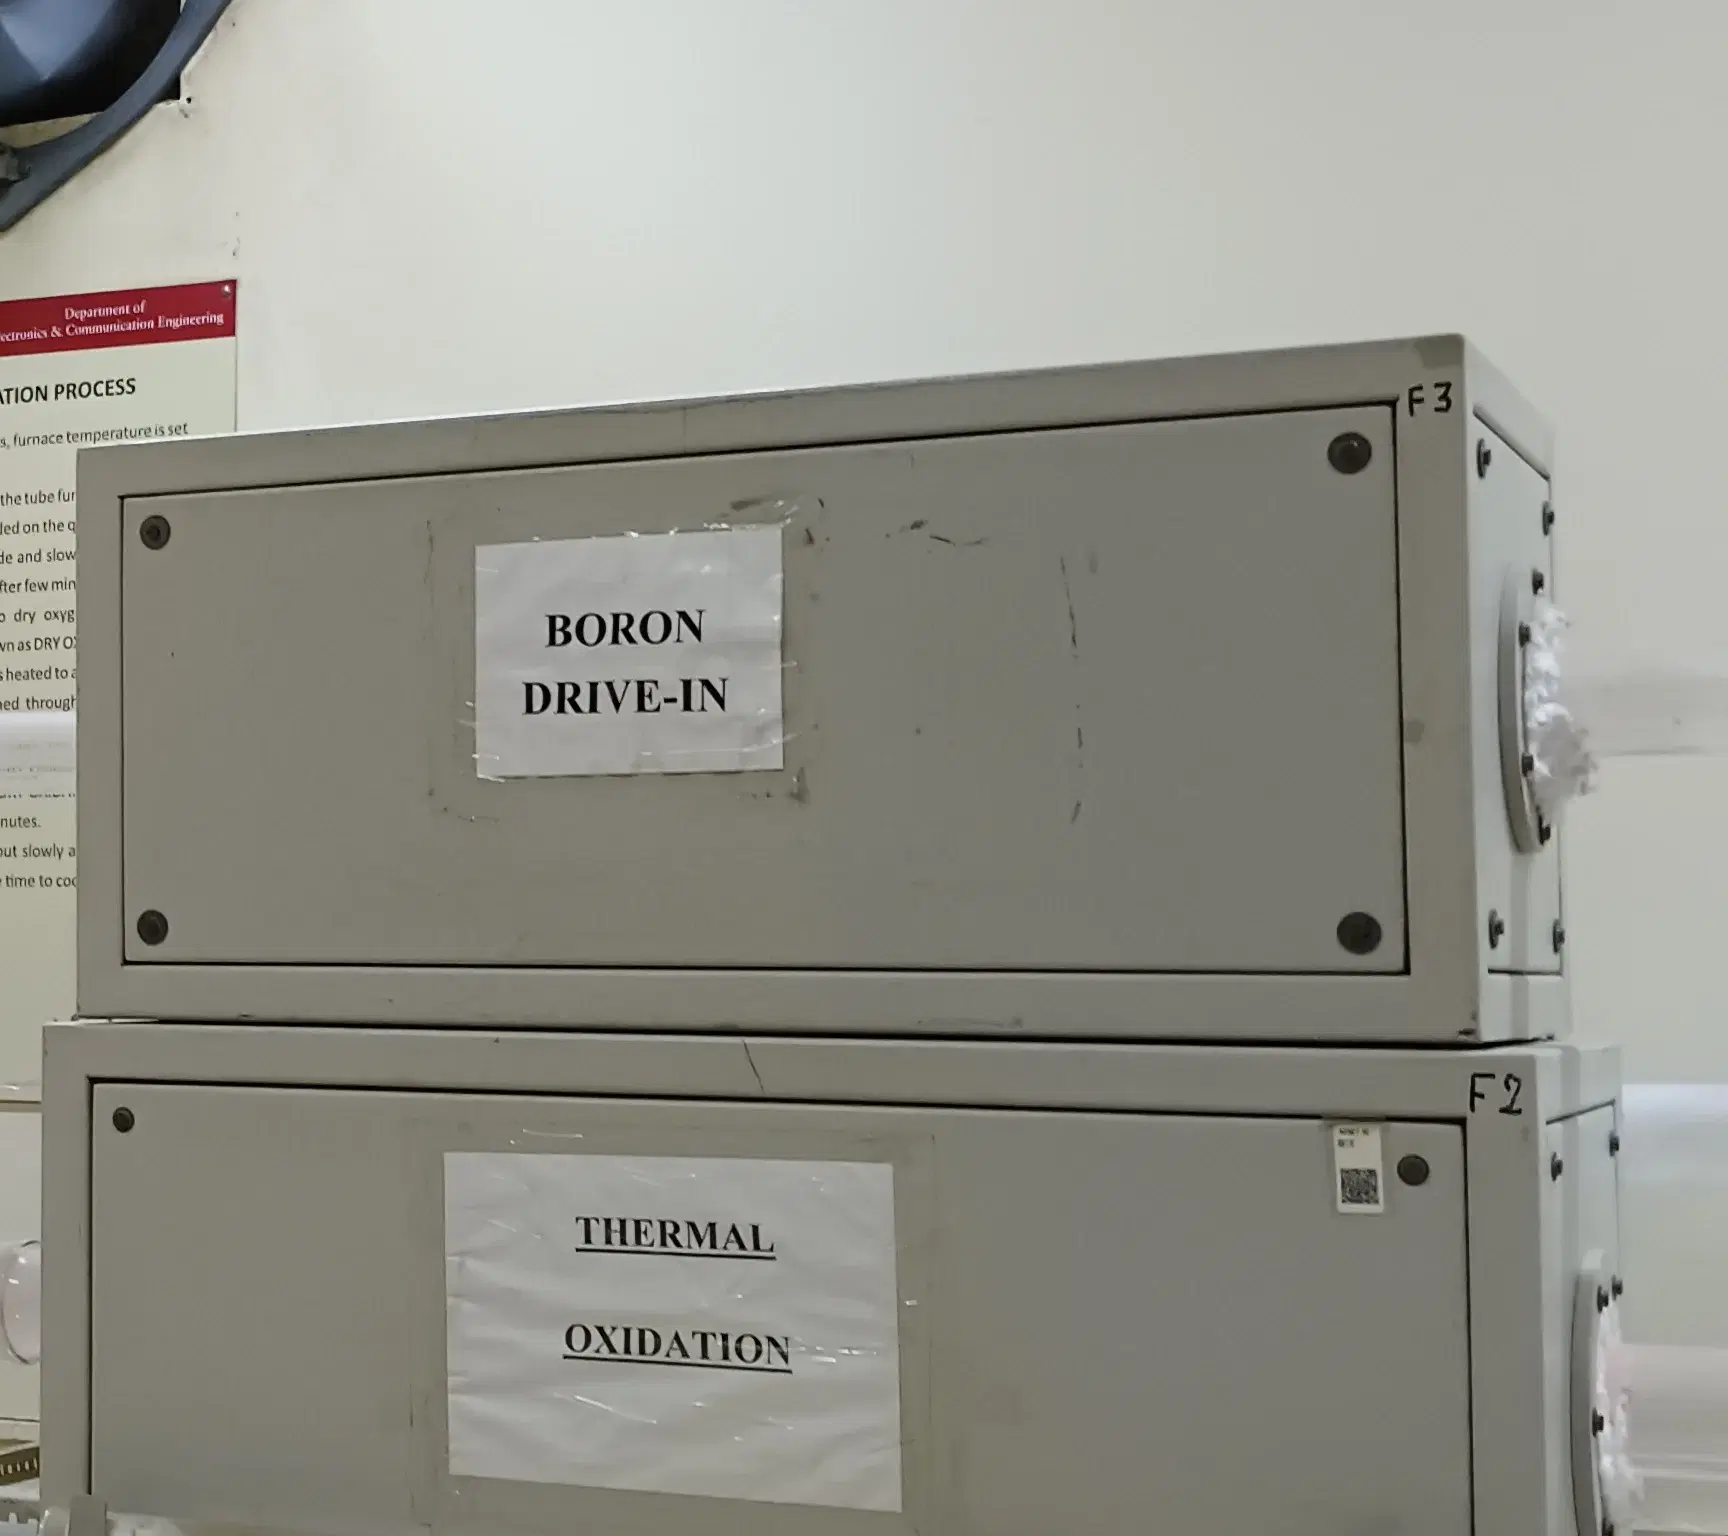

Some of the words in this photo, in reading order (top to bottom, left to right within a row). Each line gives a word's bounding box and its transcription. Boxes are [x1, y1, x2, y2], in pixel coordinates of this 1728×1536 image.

[64, 304, 130, 322] Department
[133, 299, 146, 314] of
[50, 325, 63, 338] &
[65, 318, 154, 337] Communication
[157, 310, 224, 330] Engineering
[54, 377, 137, 401] PROCESS
[13, 432, 63, 448] furnace
[66, 425, 152, 445] temperature
[154, 423, 165, 437] is
[167, 422, 188, 436] set
[0, 491, 22, 506] the
[24, 488, 55, 505] tube
[22, 522, 40, 534] on
[42, 518, 65, 533] the
[17, 547, 42, 564] and
[24, 577, 49, 593] few
[51, 576, 76, 592] min
[13, 607, 37, 624] dry
[43, 609, 75, 624] oxyg
[544, 608, 707, 649] BORON
[17, 640, 32, 652] as
[34, 635, 61, 651] DRY
[5, 664, 52, 682] heated
[54, 666, 69, 680] to
[521, 676, 729, 716] DRIVE-IN
[22, 842, 64, 861] slowly
[5, 873, 36, 888] time
[39, 875, 53, 888] to
[575, 1215, 776, 1254] THERMAL
[564, 1323, 791, 1365] OXIDATION
